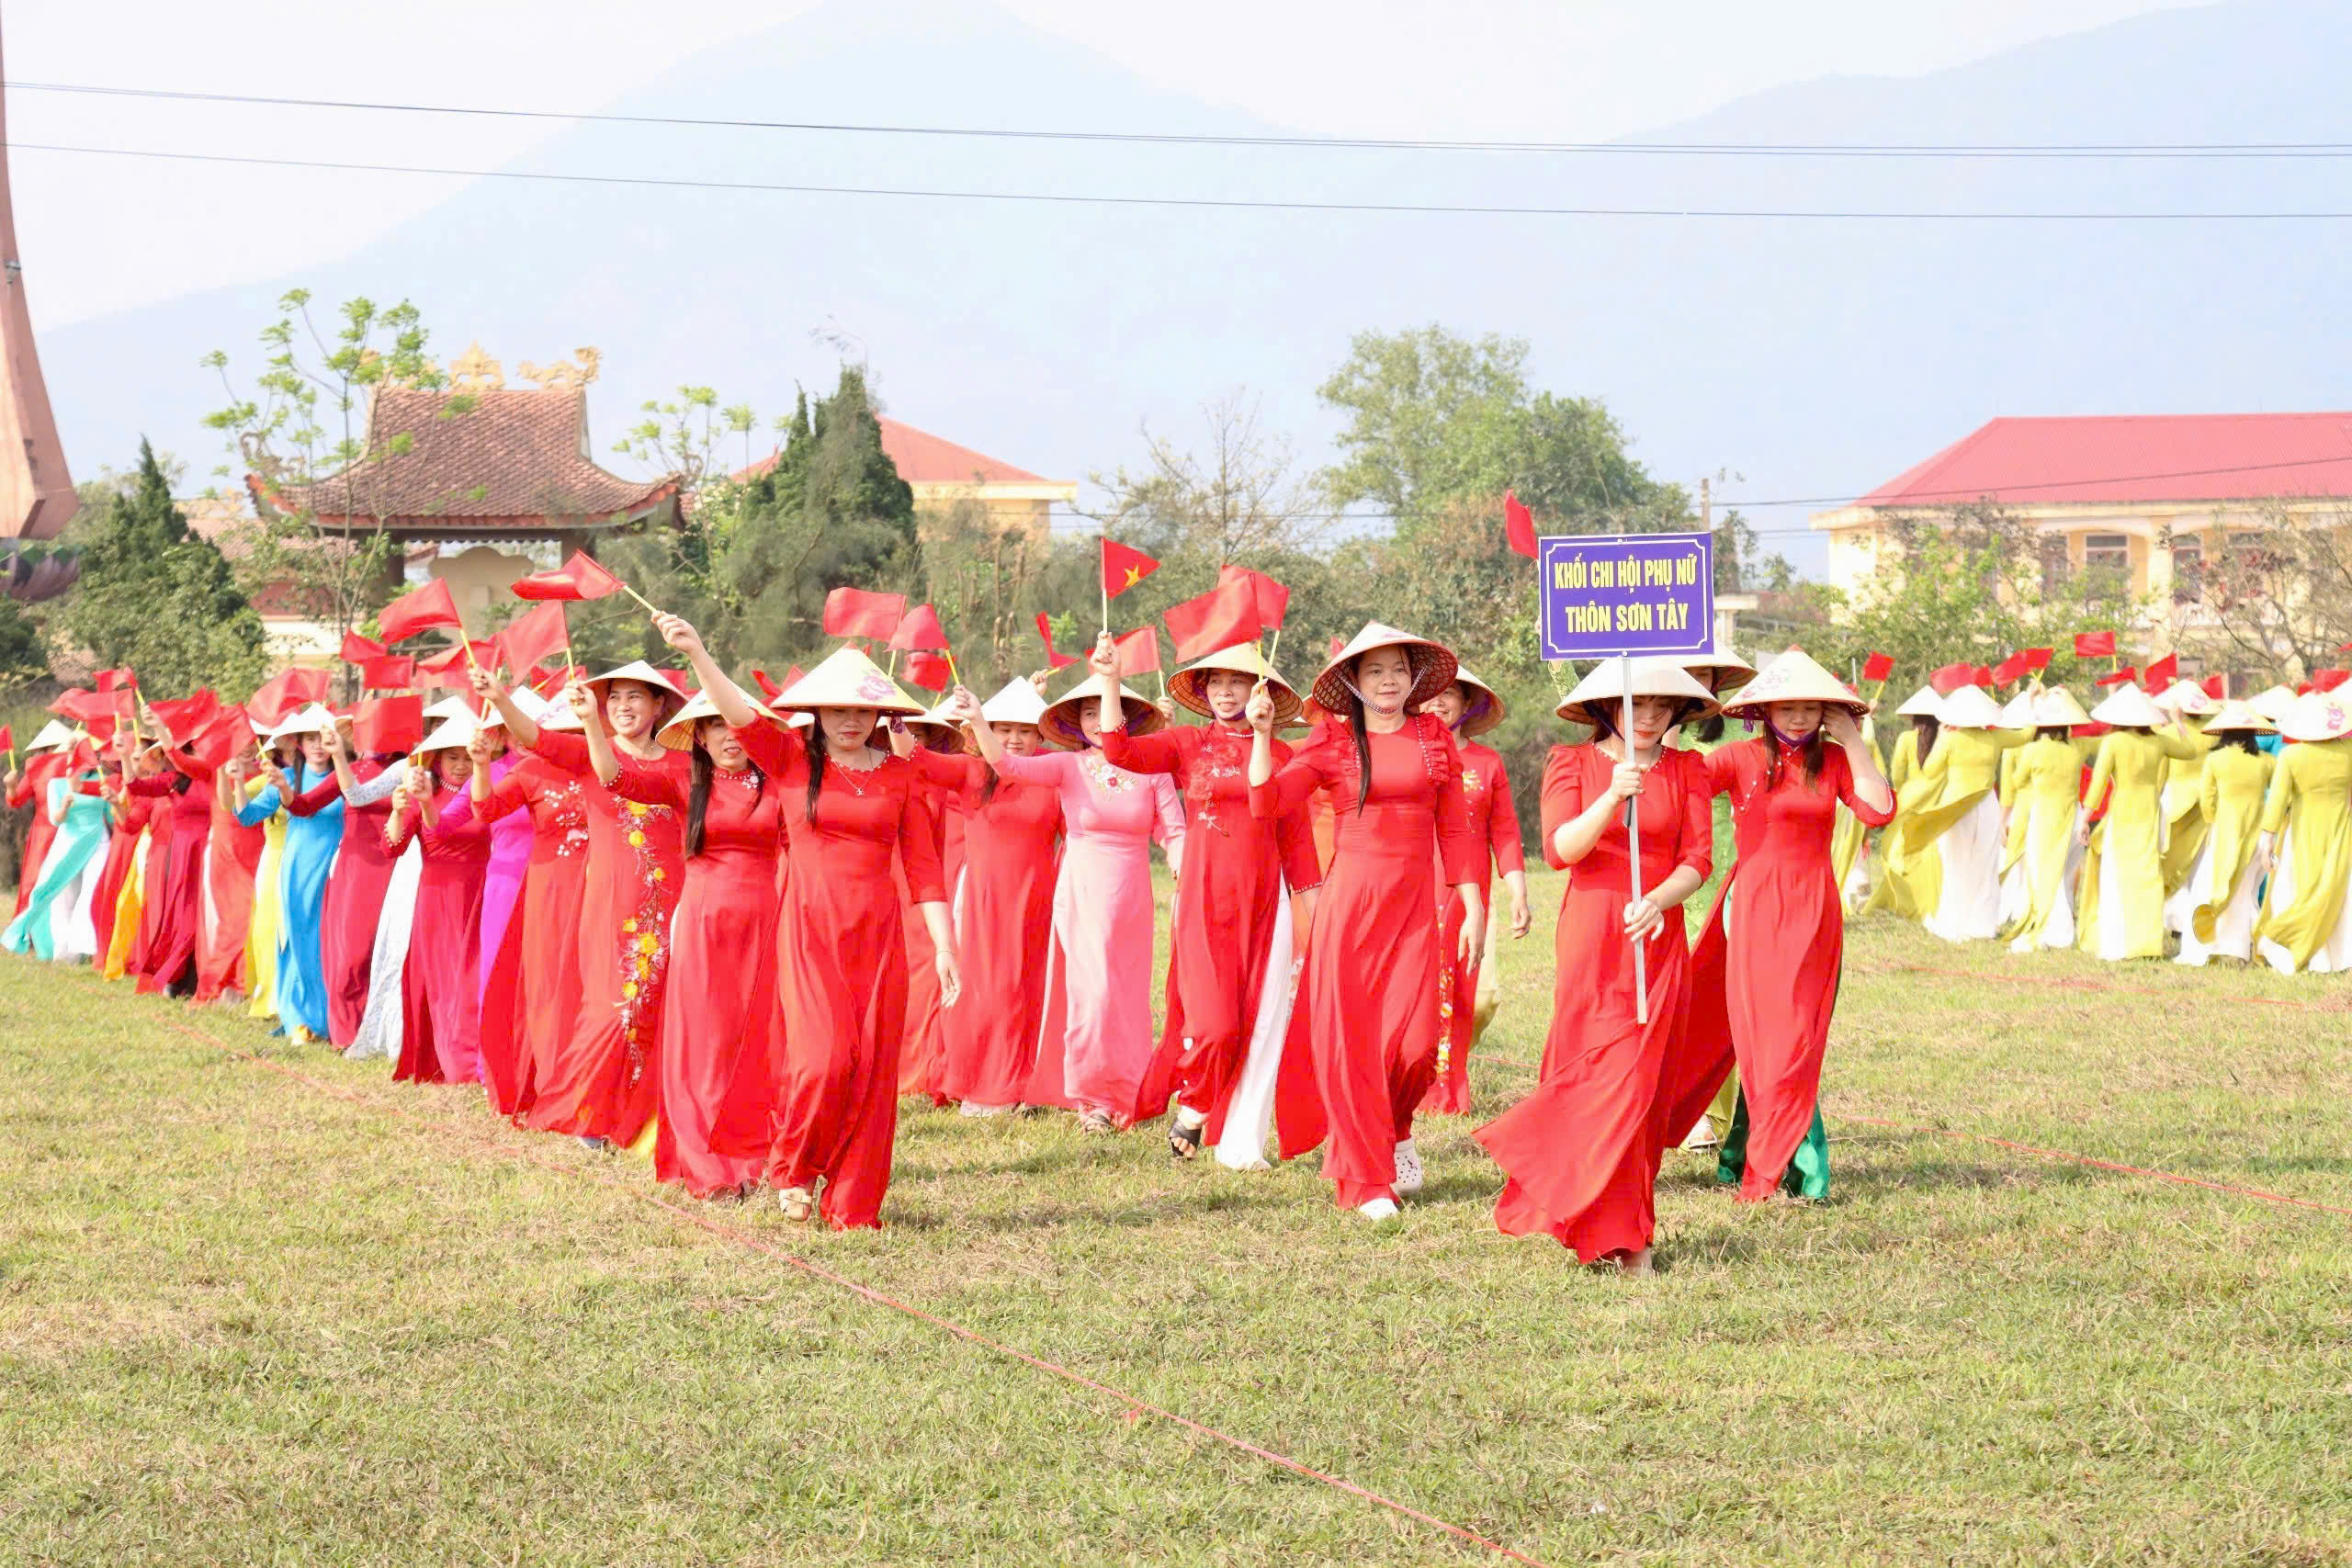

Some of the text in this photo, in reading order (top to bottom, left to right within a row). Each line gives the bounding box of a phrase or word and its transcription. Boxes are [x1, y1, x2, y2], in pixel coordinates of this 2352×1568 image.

[1555, 553, 1697, 594] KHỐI CHI HỘI PHỤ NỮ
[1566, 598, 1688, 633] THÔN SƠN TÂY
